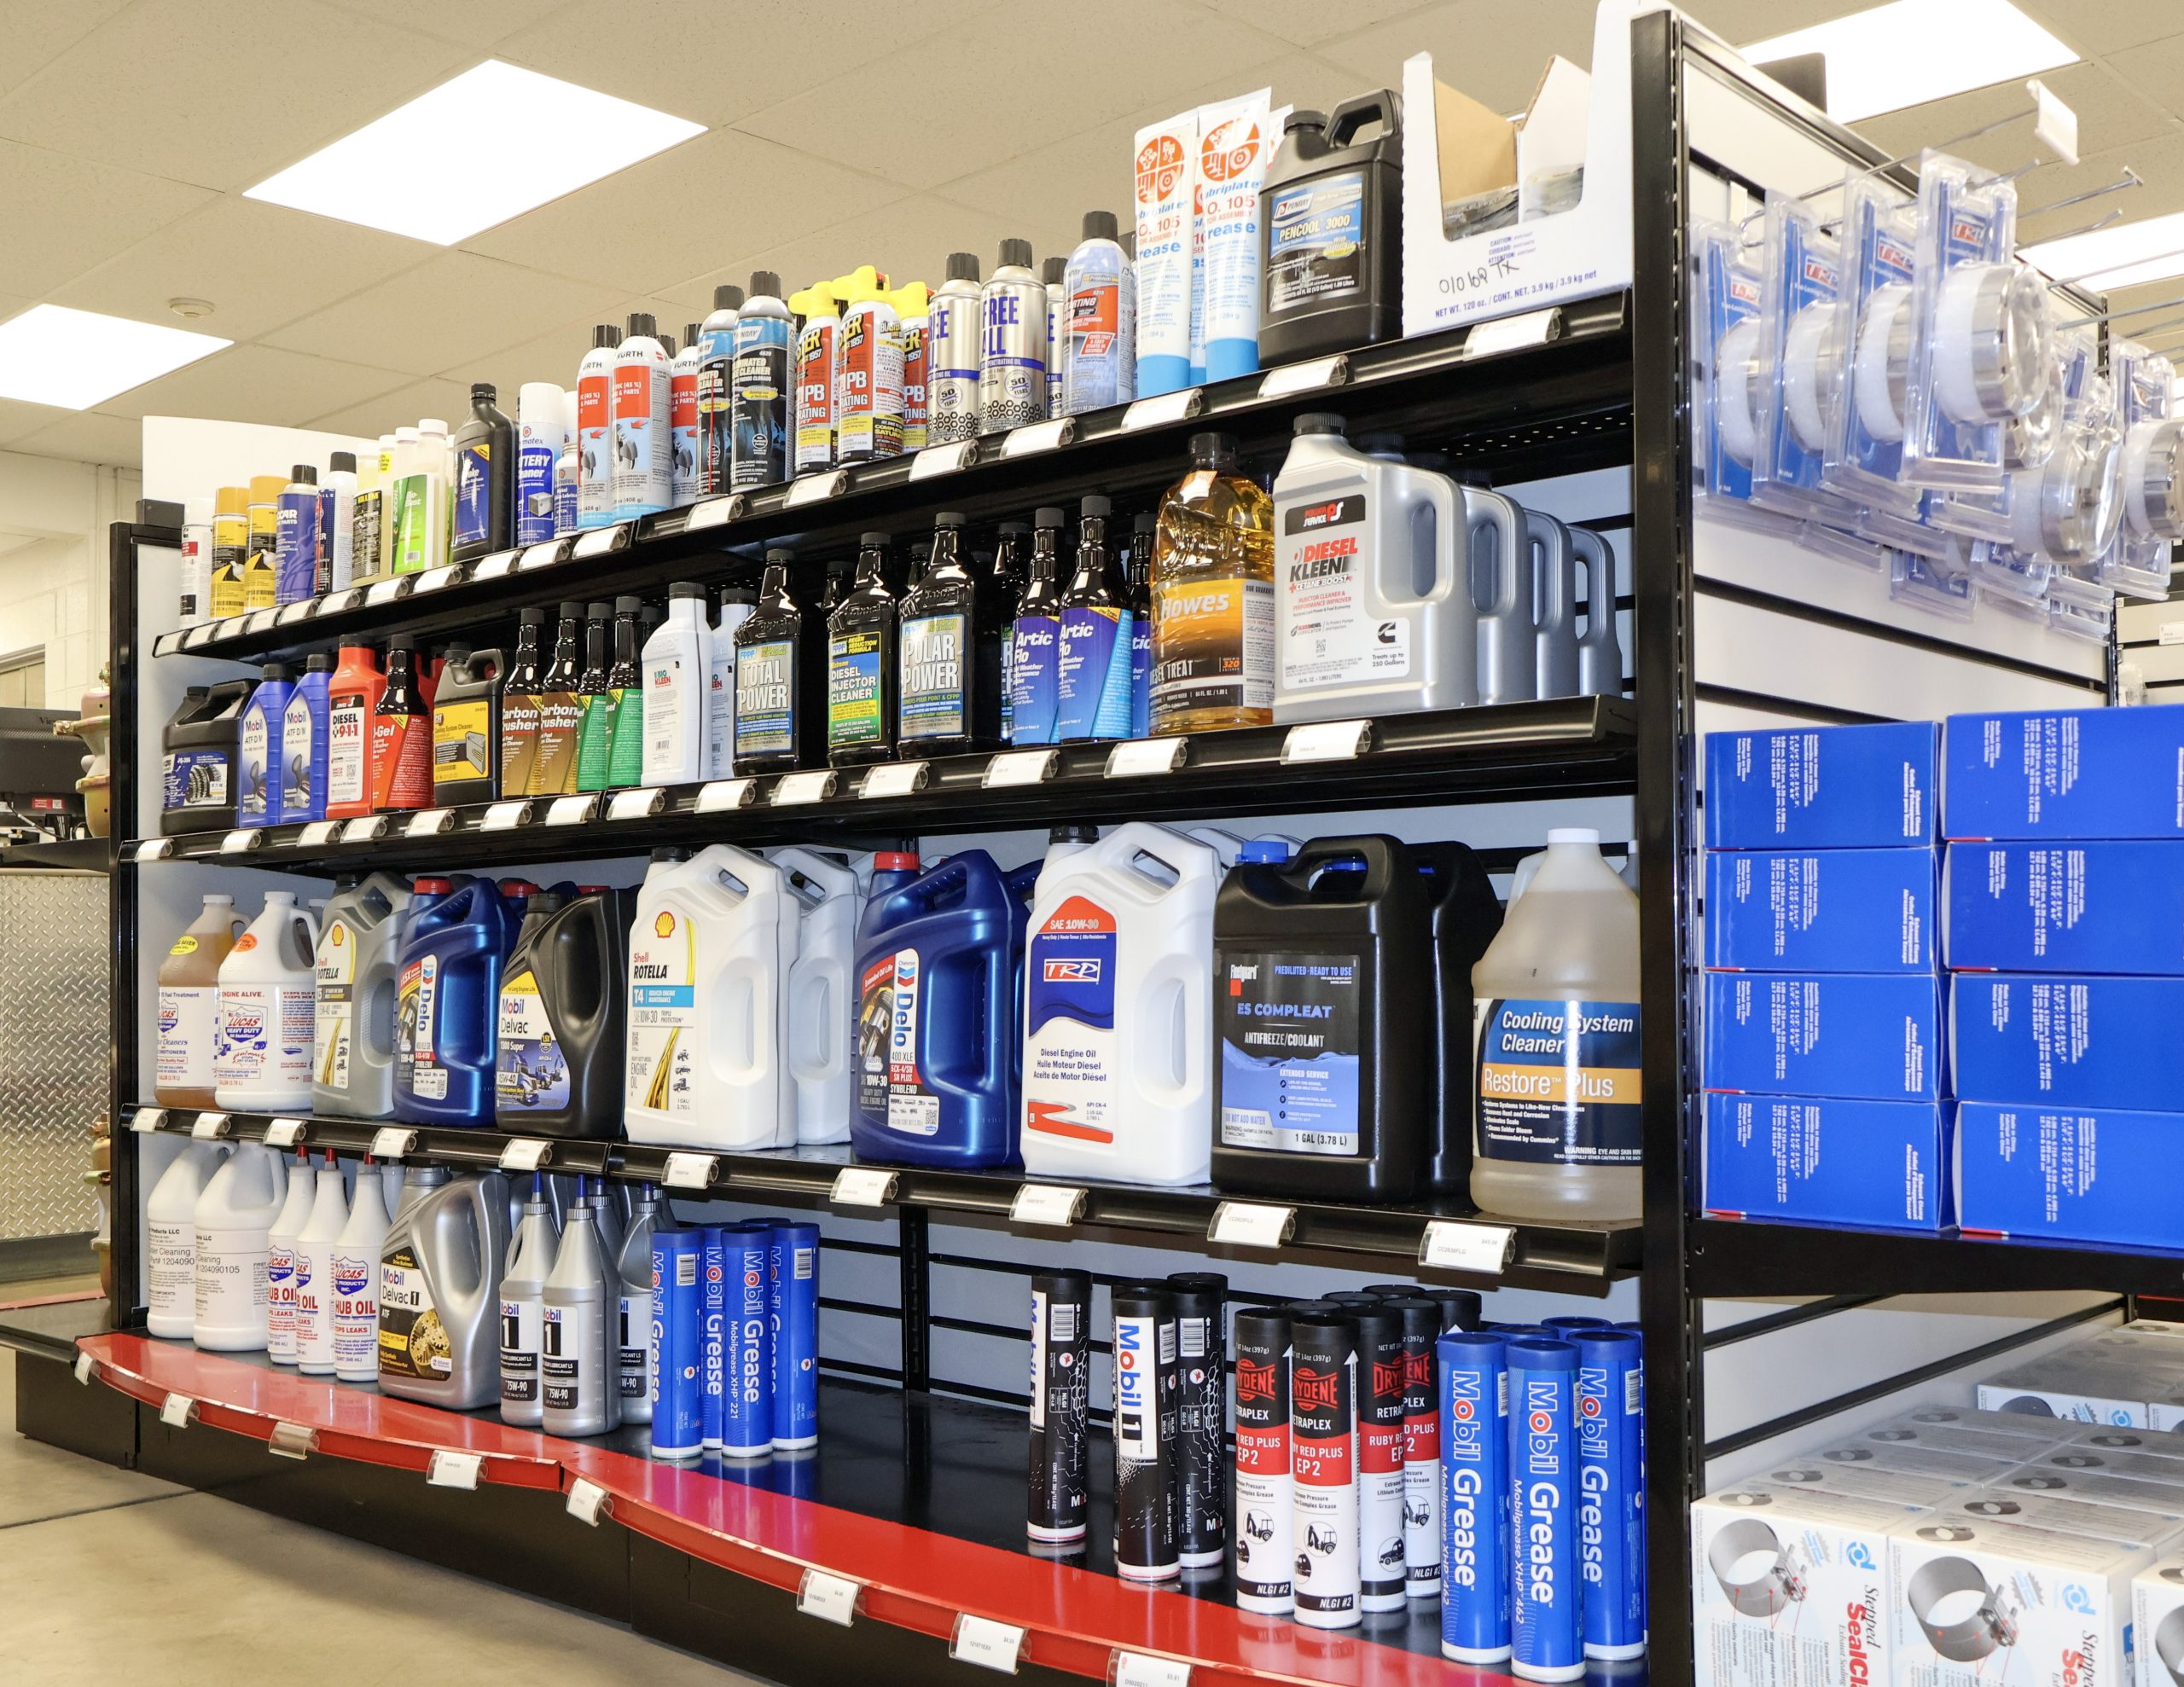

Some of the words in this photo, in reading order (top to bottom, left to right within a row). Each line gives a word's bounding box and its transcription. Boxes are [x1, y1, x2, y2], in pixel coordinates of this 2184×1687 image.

[1228, 195, 1255, 211] 105
[1157, 215, 1181, 230] 105
[1279, 219, 1321, 242] PENCOOL
[1326, 215, 1350, 230] 3000
[1208, 222, 1256, 240] rease
[1435, 306, 1447, 317] NET
[1449, 304, 1461, 315] WT.
[1464, 301, 1476, 311] 120
[1478, 299, 1487, 308] oz.
[1493, 293, 1513, 303] CONT.
[1514, 288, 1530, 298] NET.
[1531, 283, 1543, 293] 3.9
[1545, 281, 1554, 292] kg
[1560, 276, 1572, 286] 3.9
[1573, 275, 1583, 284] kg
[1584, 270, 1597, 280] net
[850, 335, 863, 350] 1957
[808, 351, 822, 362] 1957
[846, 371, 867, 391] PB
[804, 384, 826, 401] PB
[941, 388, 956, 397] 50
[1304, 537, 1358, 563] DIESEL
[1322, 575, 1348, 585] BOOST
[1161, 593, 1229, 620] Howes
[1017, 630, 1053, 647] Artic
[1059, 622, 1094, 639] Artic
[832, 642, 846, 654] FPPF
[848, 640, 878, 649] REDUCTION
[848, 646, 872, 654] FORMULA
[905, 634, 956, 667] POLAR
[1167, 660, 1193, 680] TREAT
[1384, 658, 1405, 667] Gallons
[742, 659, 784, 688] TOTAL
[831, 666, 861, 681] DIESEL
[903, 662, 959, 694] POWER
[831, 676, 876, 693] INJECTOR
[738, 685, 788, 713] POWER
[831, 689, 873, 704] CLEANER
[246, 719, 263, 732] Mobil
[287, 710, 306, 725] Mobil
[332, 713, 357, 725] DIESEL
[1050, 919, 1064, 930] SAE
[1066, 919, 1099, 930] 10W-30
[634, 952, 649, 963] Shell
[317, 968, 339, 980] ROTELLA
[634, 965, 668, 979] ROTELLA
[1045, 962, 1098, 980] TRP
[1230, 965, 1258, 982] Fleetguard
[1275, 965, 1307, 976] PREDILUTED
[1310, 966, 1330, 976] READY
[1331, 966, 1339, 976] TO
[1339, 967, 1352, 976] USE
[634, 988, 644, 1004] T4
[419, 989, 433, 1032] Delo
[502, 999, 525, 1014] Mobil
[1237, 1003, 1252, 1015] ES
[1254, 1003, 1333, 1018] COMPLEAT
[228, 1017, 259, 1027] LUCAS
[501, 1018, 528, 1034] Delvac
[894, 993, 914, 1047] Delo
[1502, 1011, 1564, 1034] Cooling
[510, 1042, 525, 1052] Super
[1244, 1031, 1325, 1048] ANTIFREEZE/COOLANT
[1502, 1034, 1565, 1053] Cleaner
[891, 1052, 902, 1061] 400
[902, 1052, 914, 1062] XLE
[1041, 1049, 1060, 1058] Diesel
[1060, 1049, 1083, 1059] Engine
[1086, 1049, 1096, 1058] Oil
[1037, 1060, 1051, 1070] Huile
[1053, 1061, 1076, 1070] Moteur
[1077, 1061, 1101, 1070] Diesel
[866, 1075, 888, 1087] 10W-30
[1033, 1071, 1050, 1081] Aceite
[1060, 1072, 1081, 1081] Motor
[1082, 1072, 1107, 1082] Diésel
[1280, 1069, 1305, 1078] EXTENDED
[1306, 1070, 1329, 1079] SERVICE
[890, 1084, 917, 1094] SYNBLEND
[1573, 1072, 1614, 1097] Plus
[1302, 1133, 1315, 1143] GAL
[1317, 1134, 1337, 1145] (3.78
[1339, 1135, 1348, 1145] L)
[159, 1248, 191, 1257] Cleaning
[199, 1266, 240, 1274] 1204090105
[335, 1269, 363, 1278] LUCAS
[382, 1268, 404, 1285] Mobil
[706, 1246, 723, 1309] Mobil
[652, 1250, 664, 1316] Mobil
[744, 1250, 764, 1315] Mobil
[382, 1285, 409, 1304] Delvac
[335, 1301, 352, 1315] HUB
[355, 1301, 376, 1314] OIL
[381, 1308, 390, 1318] ATF
[706, 1313, 723, 1396] Grease
[729, 1320, 739, 1375] Mobilgrease
[652, 1320, 664, 1403] Grease
[744, 1319, 764, 1403] Grease
[1118, 1324, 1141, 1407] Mobil
[1312, 1354, 1331, 1363] (397g)
[507, 1380, 527, 1392] 75W-90
[549, 1388, 568, 1400] 75W-90
[729, 1401, 739, 1419] 221
[1453, 1370, 1481, 1462] Mobil
[1581, 1367, 1607, 1458] Mobil
[1412, 1423, 1434, 1435] PLUS
[1529, 1381, 1558, 1475] Mobil
[1240, 1436, 1254, 1447] RED
[1256, 1437, 1281, 1448] PLUS
[1369, 1436, 1392, 1446] RUBY
[1238, 1450, 1249, 1463] EP
[1250, 1452, 1258, 1465] 2
[1298, 1446, 1313, 1457] RED
[1315, 1446, 1343, 1458] PLUS
[1297, 1458, 1310, 1473] EP
[1311, 1460, 1321, 1476] 2
[1513, 1479, 1522, 1559] Mobilgrease
[1581, 1465, 1608, 1584] Grease
[1453, 1469, 1482, 1587] Grease
[1529, 1481, 1560, 1603] Grease
[1414, 1567, 1431, 1577] NLGI
[1514, 1560, 1524, 1591] XHP
[1257, 1584, 1277, 1595] NLGI
[1277, 1583, 1290, 1595] #2
[1320, 1597, 1340, 1608] NLGI
[1341, 1596, 1352, 1609] #2
[1515, 1597, 1525, 1625] 462
[1862, 1585, 1882, 1649] Stepped
